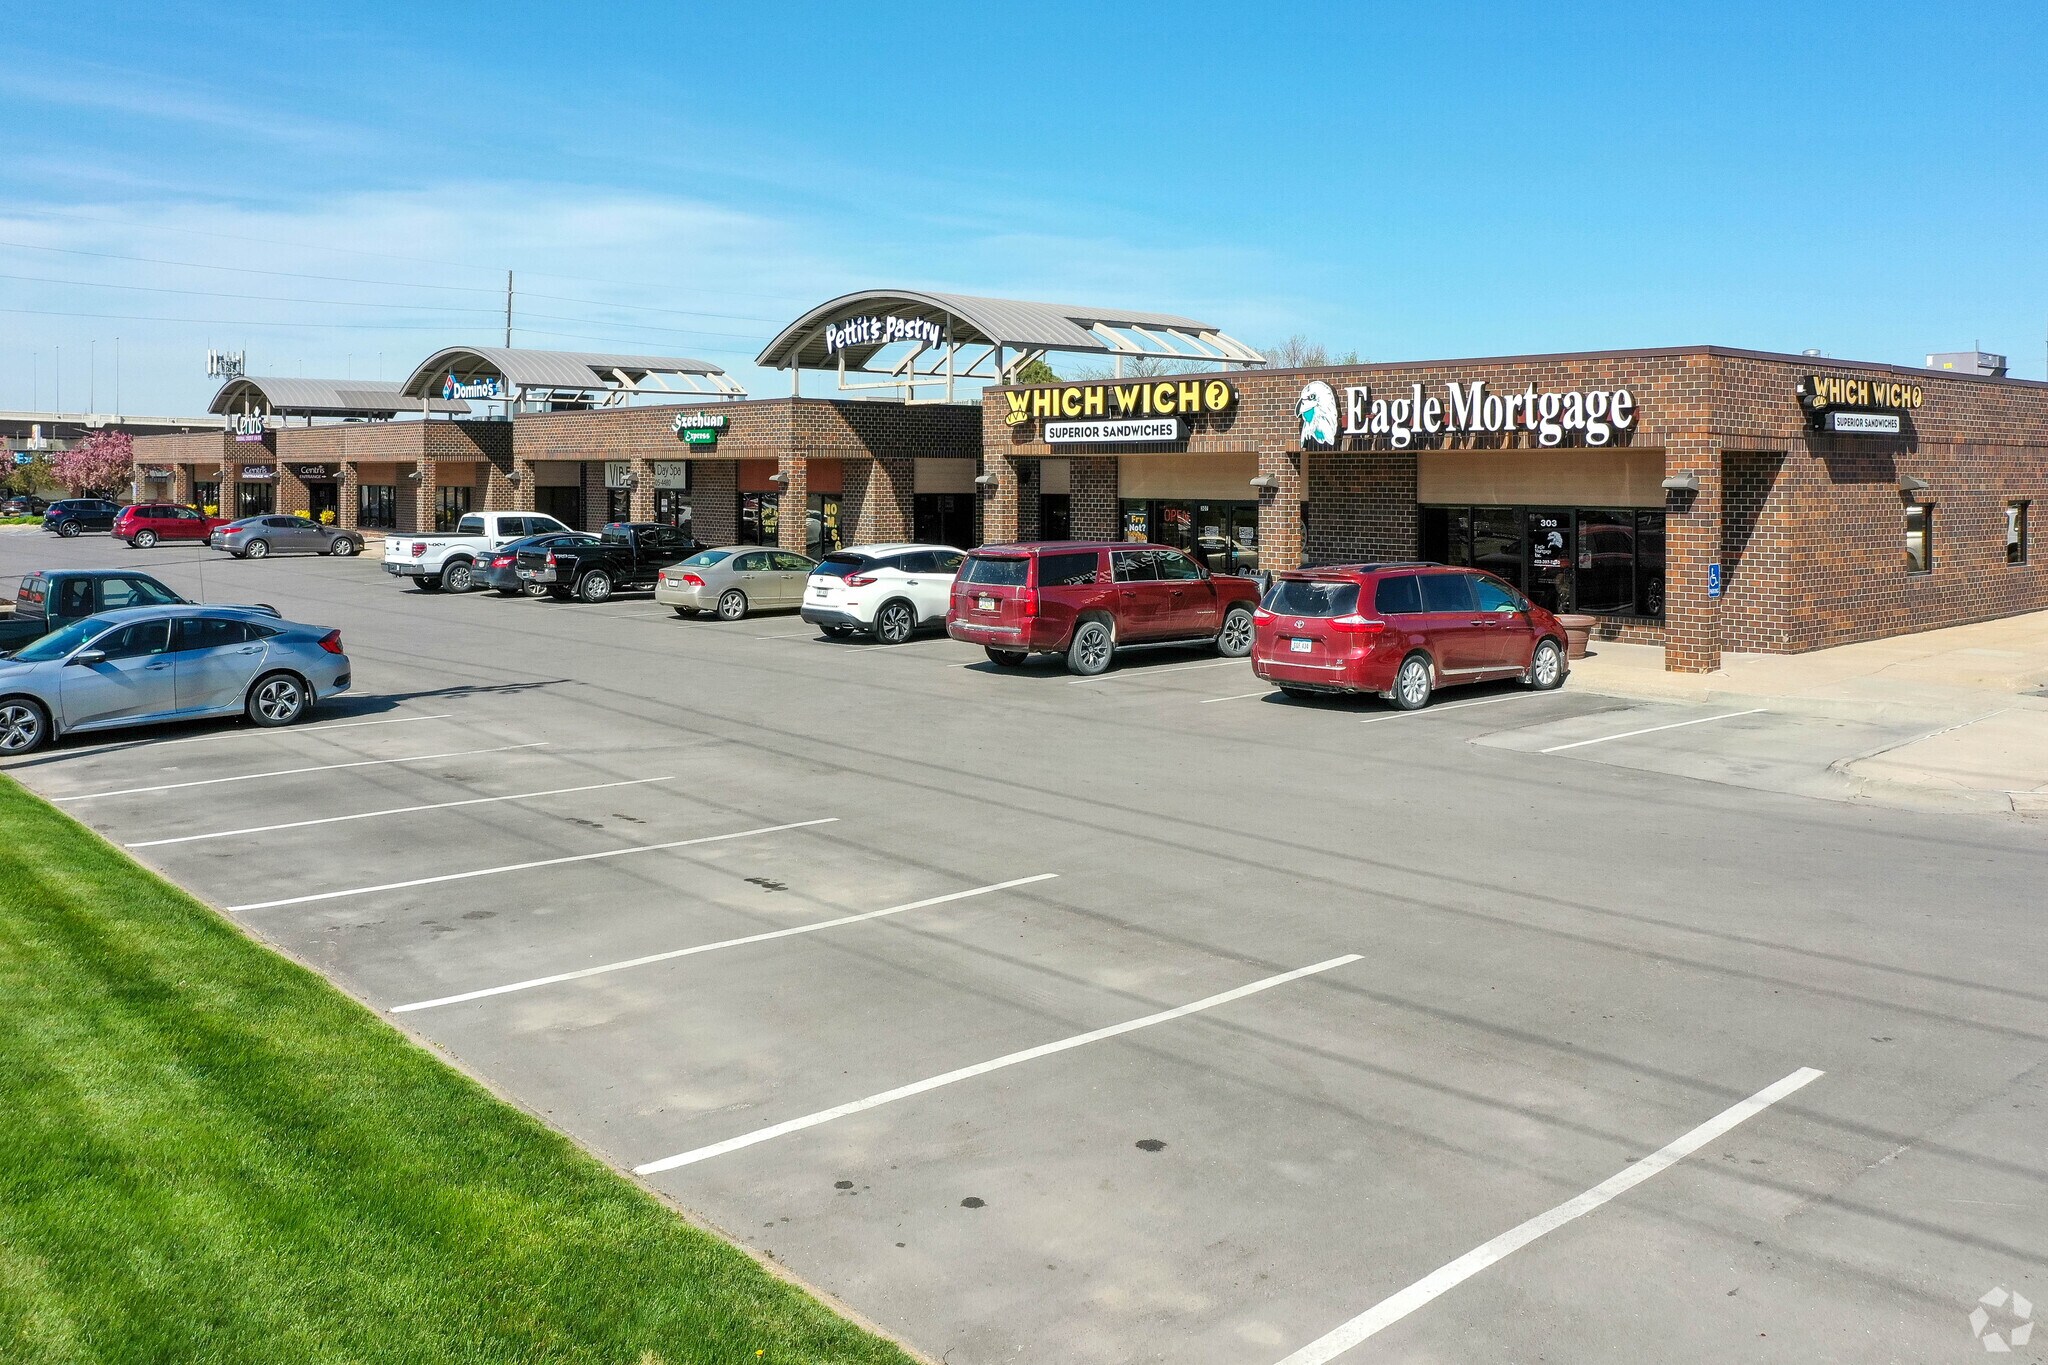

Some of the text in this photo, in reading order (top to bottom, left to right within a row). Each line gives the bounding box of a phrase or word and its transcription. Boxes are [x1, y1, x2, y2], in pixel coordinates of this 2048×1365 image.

[826, 315, 940, 355] Pettit's Pastry
[453, 378, 494, 399] Domino's
[1813, 376, 1868, 405] WHICH
[1005, 386, 1104, 418] WHICH
[671, 411, 724, 432] Szechuan
[1344, 381, 1634, 448] Eagle Mortgage
[235, 412, 262, 435] Centris
[1836, 417, 1898, 429] SUPERIOR SANDWICHES
[685, 431, 711, 442] Express
[1049, 424, 1173, 439] SUPERIOR SANDWICHES
[243, 465, 268, 475] Centris
[300, 465, 325, 475] Centris
[656, 464, 682, 479] Day Spa
[824, 503, 838, 515] NO
[1131, 515, 1144, 524] Fry
[1540, 519, 1557, 527] 303
[1129, 524, 1146, 532] Not?
